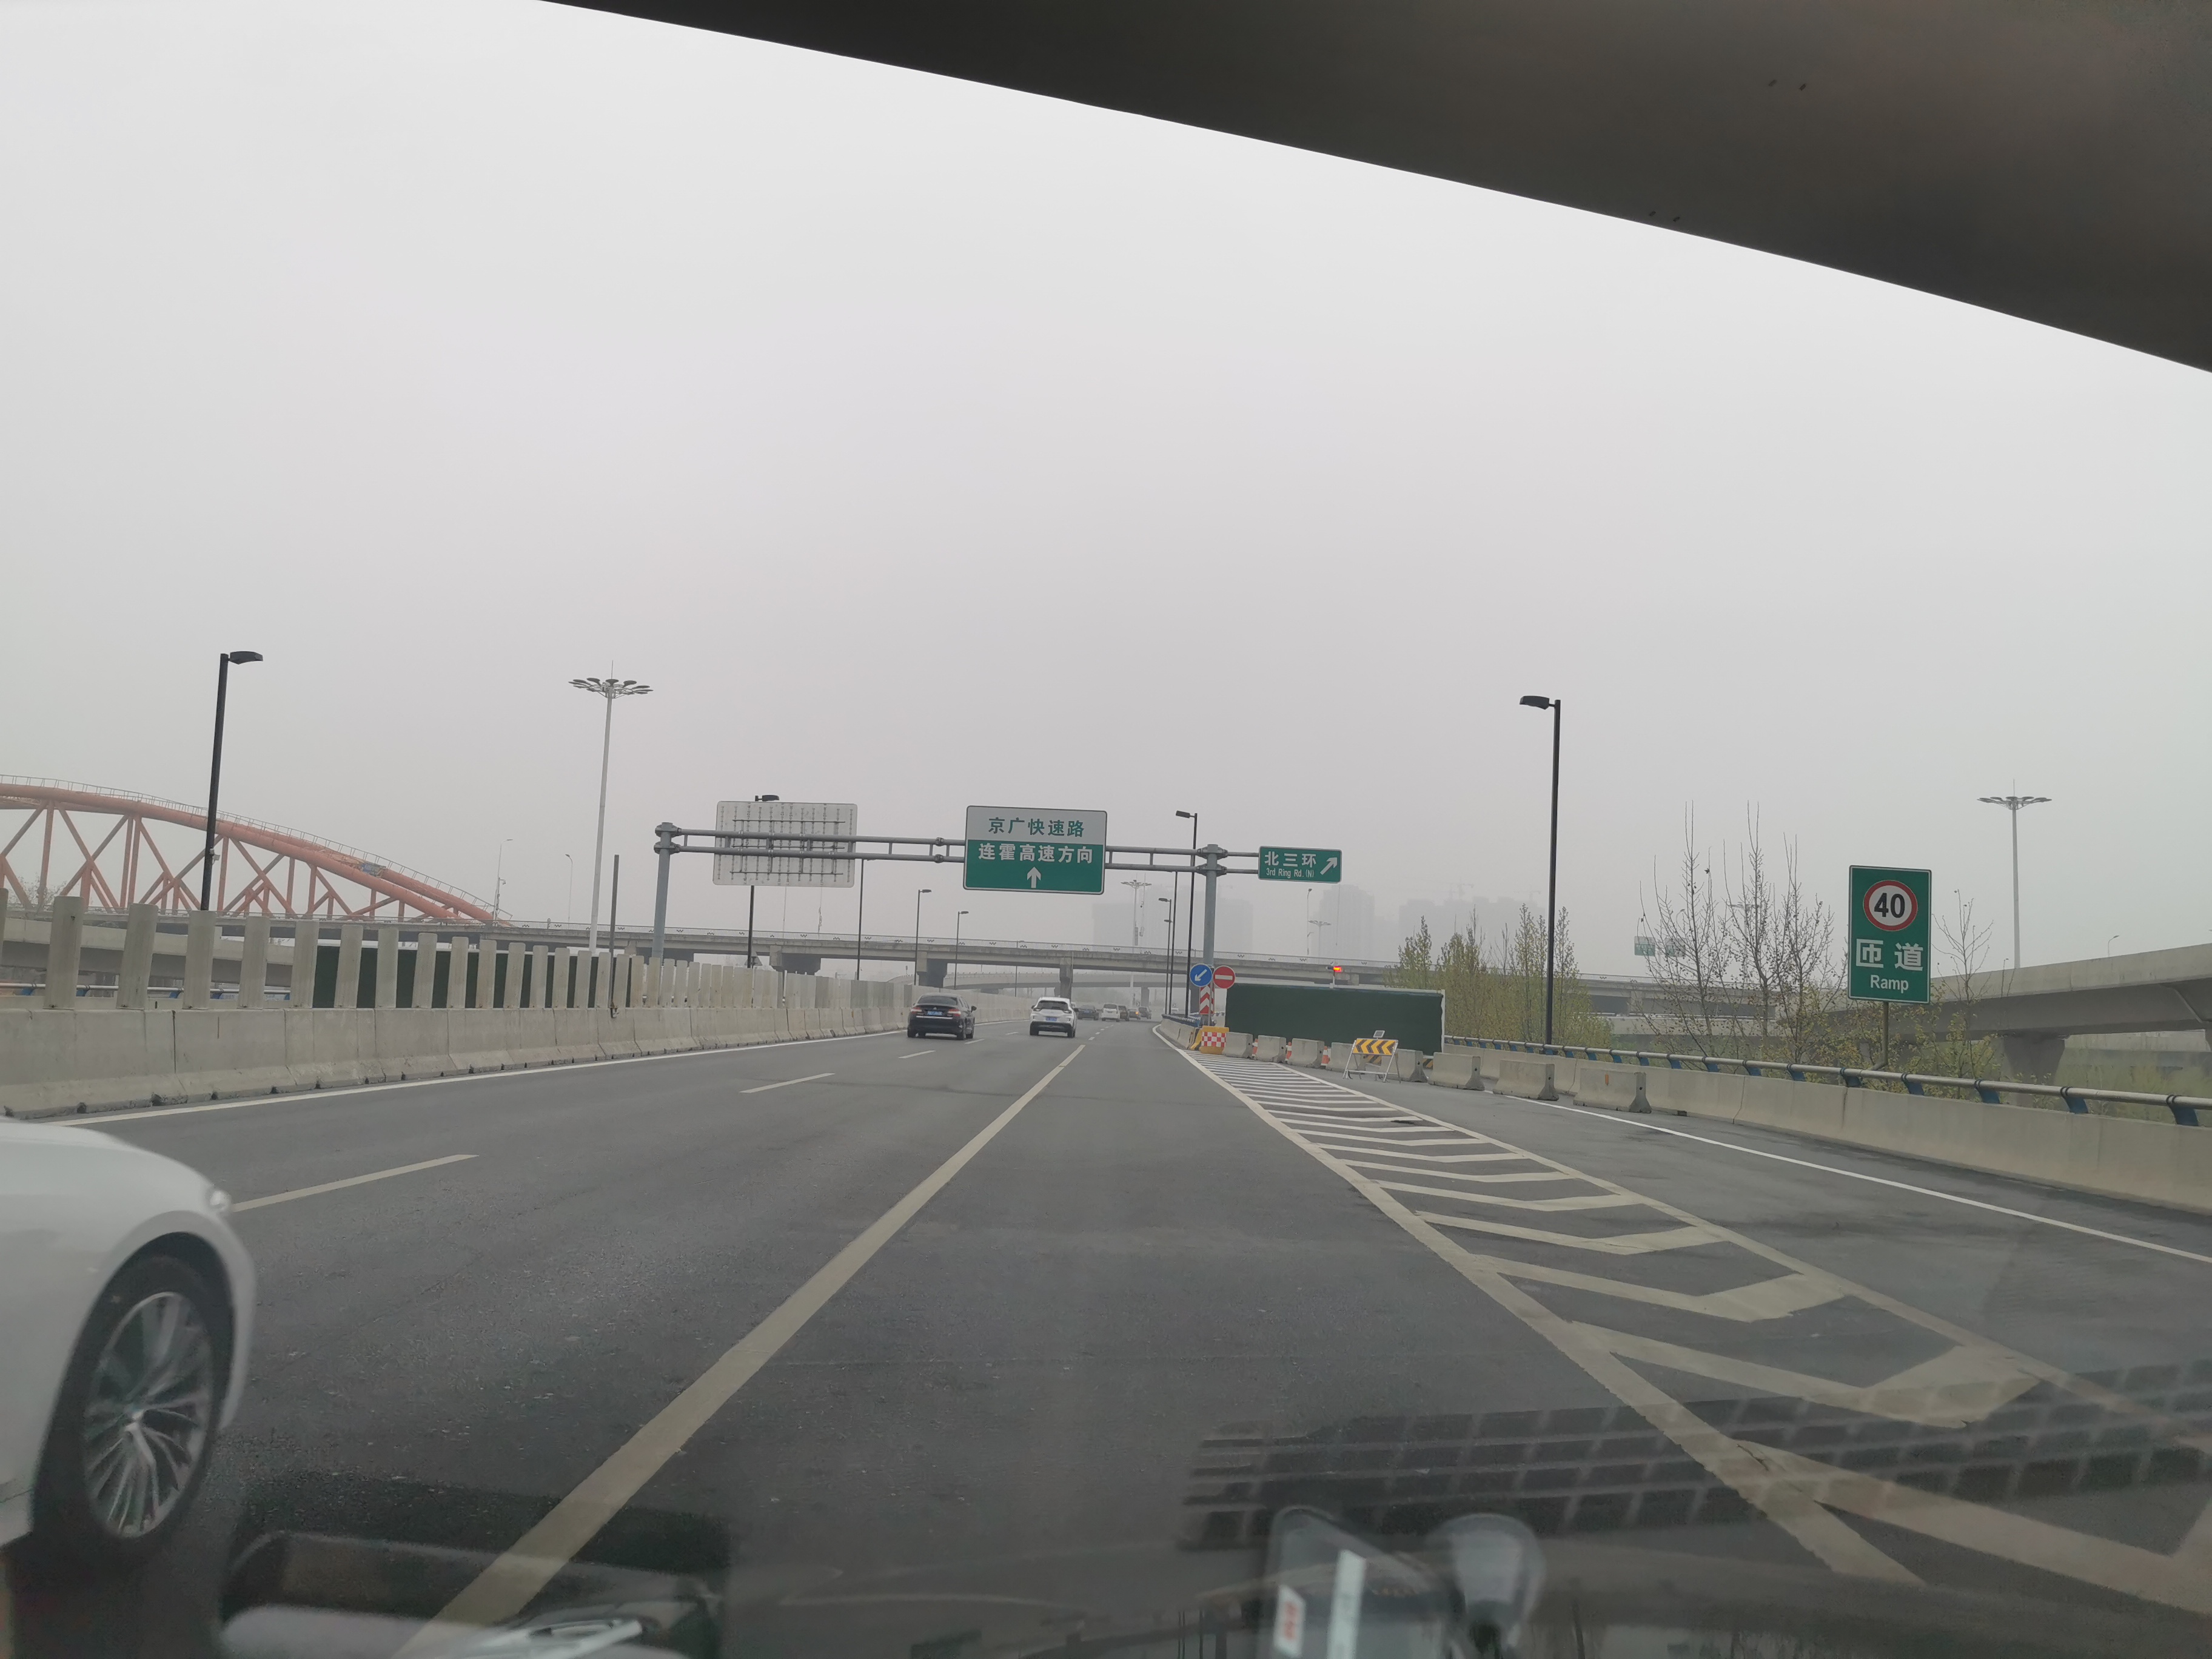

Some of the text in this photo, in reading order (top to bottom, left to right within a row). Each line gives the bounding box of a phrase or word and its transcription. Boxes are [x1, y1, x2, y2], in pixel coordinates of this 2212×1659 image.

[988, 817, 1085, 837] 京广快速路
[978, 842, 1093, 863] 连霍高速方向
[1264, 851, 1316, 868] 北三环
[1266, 867, 1276, 876] 3rd
[1278, 868, 1291, 878] Ring
[1874, 893, 1905, 918] 40
[1855, 938, 1923, 971] 匝道
[1870, 974, 1909, 994] Ramp
